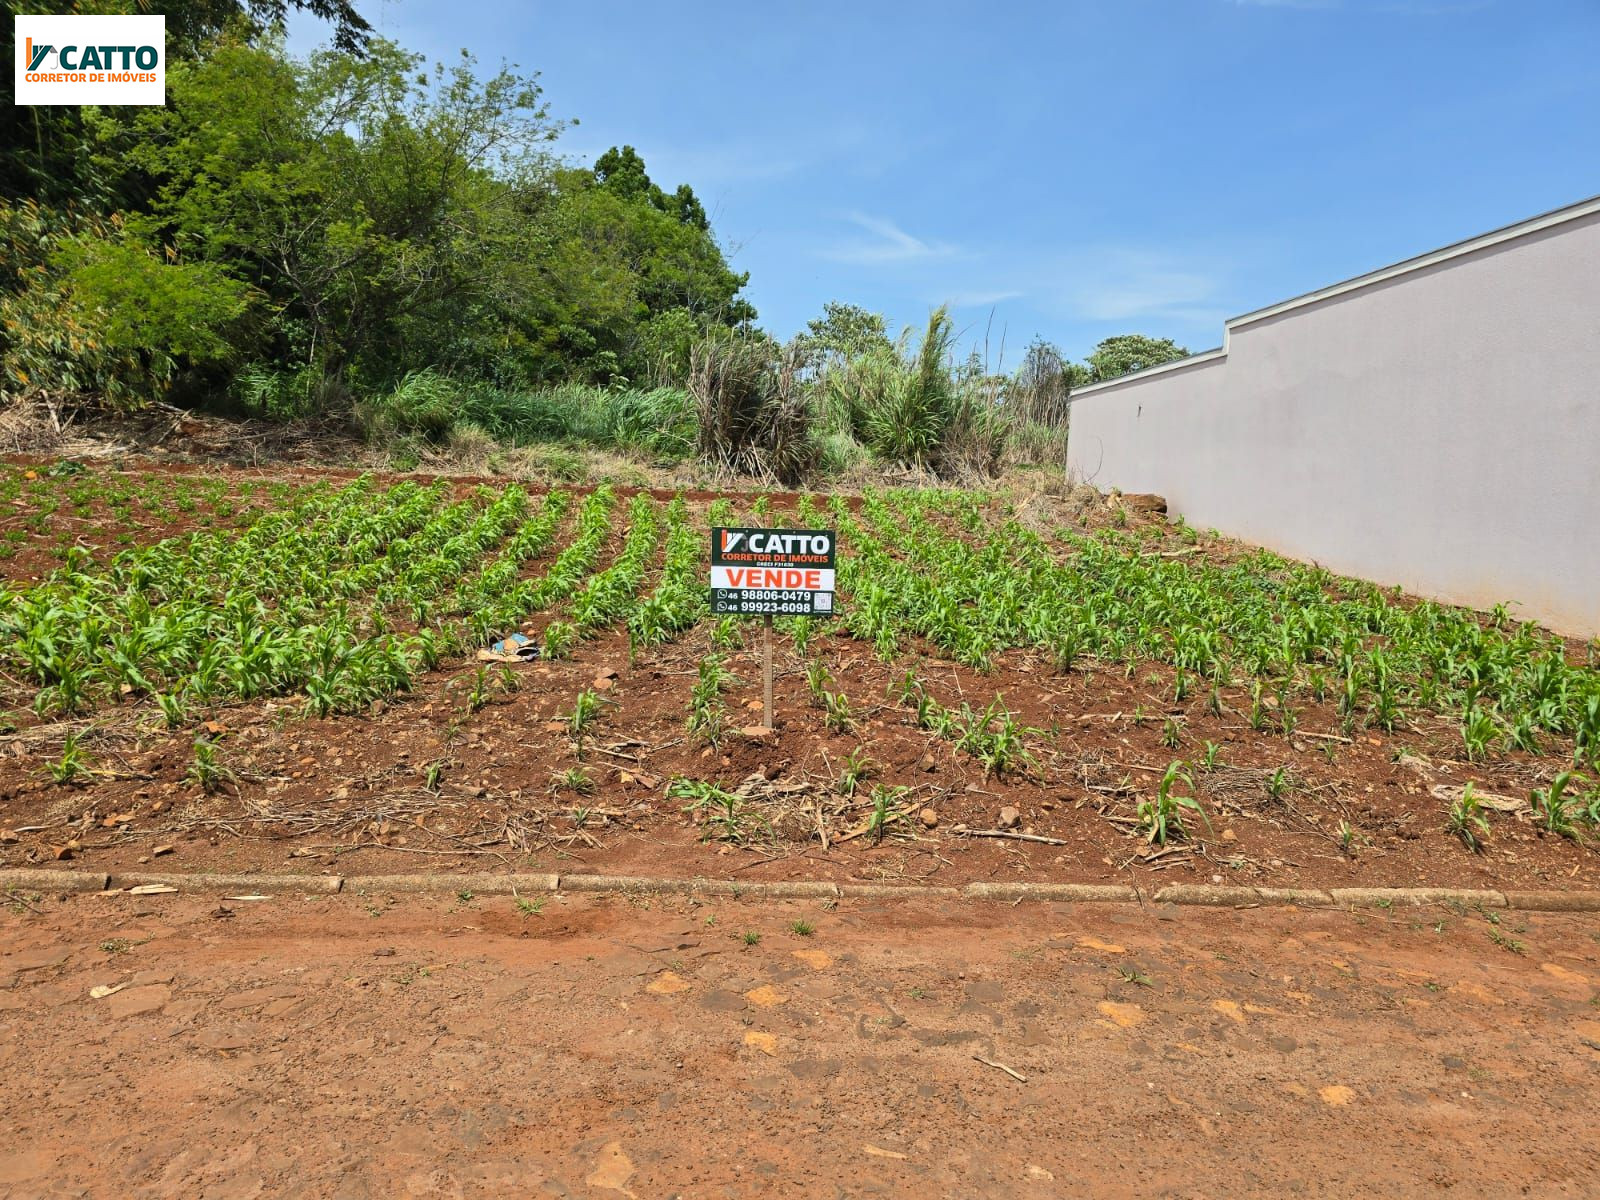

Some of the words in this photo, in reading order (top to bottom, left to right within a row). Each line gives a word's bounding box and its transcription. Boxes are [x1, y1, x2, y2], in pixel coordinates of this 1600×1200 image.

[721, 553, 771, 562] CORRETOR
[774, 554, 786, 562] DE
[789, 554, 829, 563] IMÓVEIS
[726, 568, 821, 589] VENDE
[727, 592, 738, 600] 46
[741, 590, 811, 601] 98806-0479
[741, 601, 811, 613] 99923-6098
